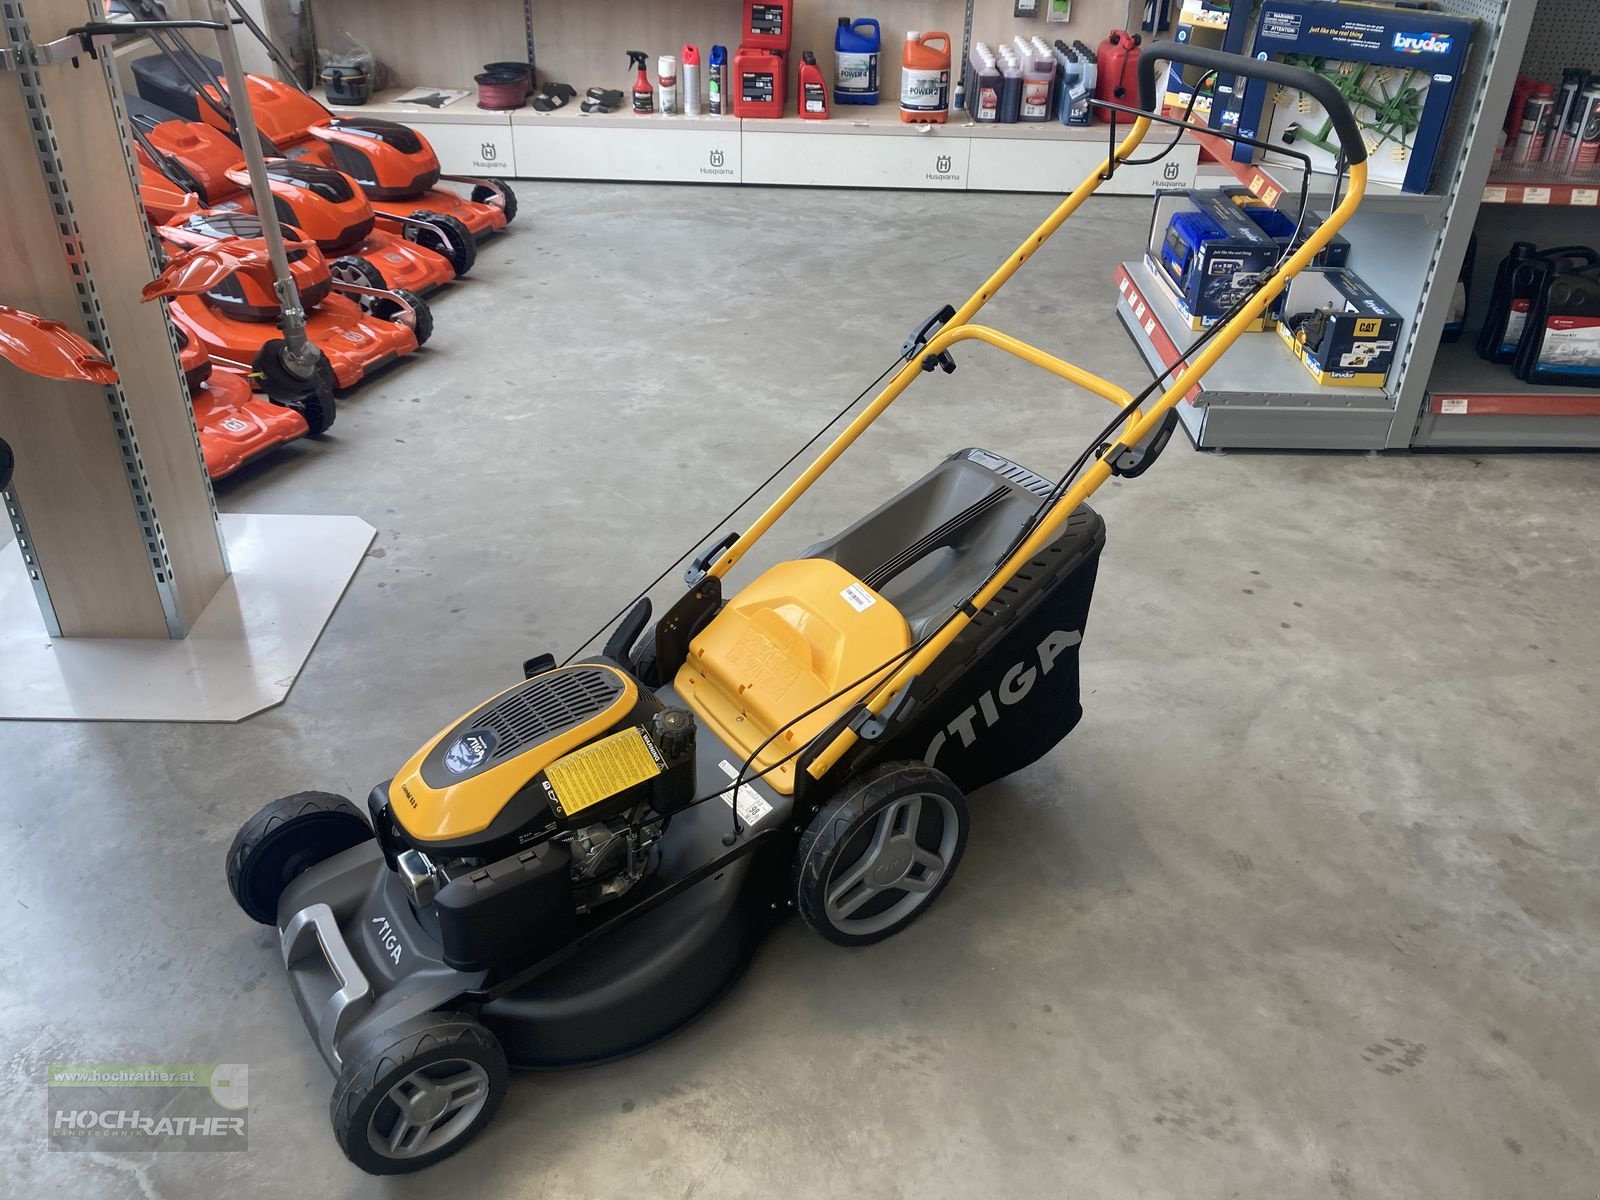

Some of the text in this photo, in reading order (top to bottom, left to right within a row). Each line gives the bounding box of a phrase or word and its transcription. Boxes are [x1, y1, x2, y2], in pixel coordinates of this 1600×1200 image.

[1349, 31, 1363, 39] thing
[1393, 33, 1450, 53] bruder
[1359, 323, 1377, 332] CAT
[923, 629, 1082, 768] STIGA
[466, 737, 485, 758] STIGA
[642, 734, 661, 762] WARNING
[749, 805, 760, 816] 98
[372, 917, 402, 965] STIGA
